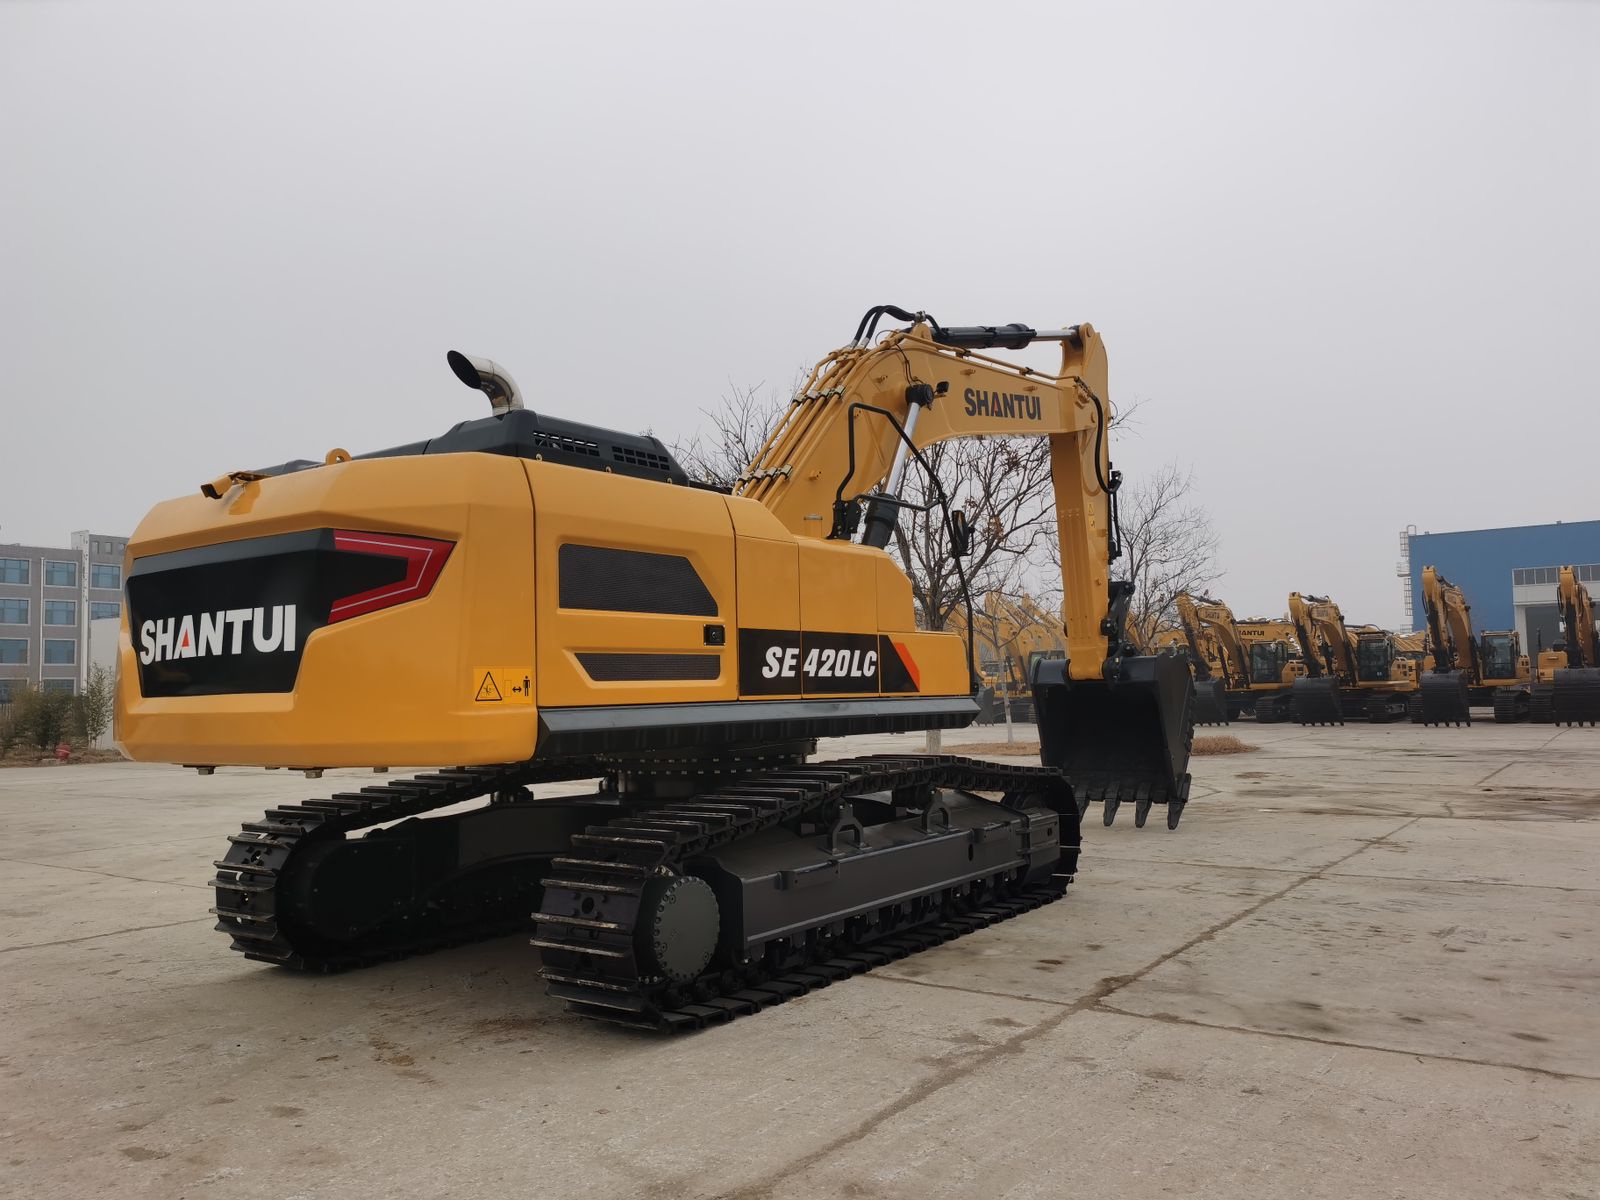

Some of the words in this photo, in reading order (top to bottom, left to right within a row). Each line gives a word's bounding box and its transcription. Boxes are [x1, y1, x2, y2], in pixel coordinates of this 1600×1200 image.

[964, 388, 1041, 420] SHANTUI
[140, 604, 297, 665] SHANTUI
[762, 646, 800, 678] SE
[803, 648, 878, 677] 420LC
